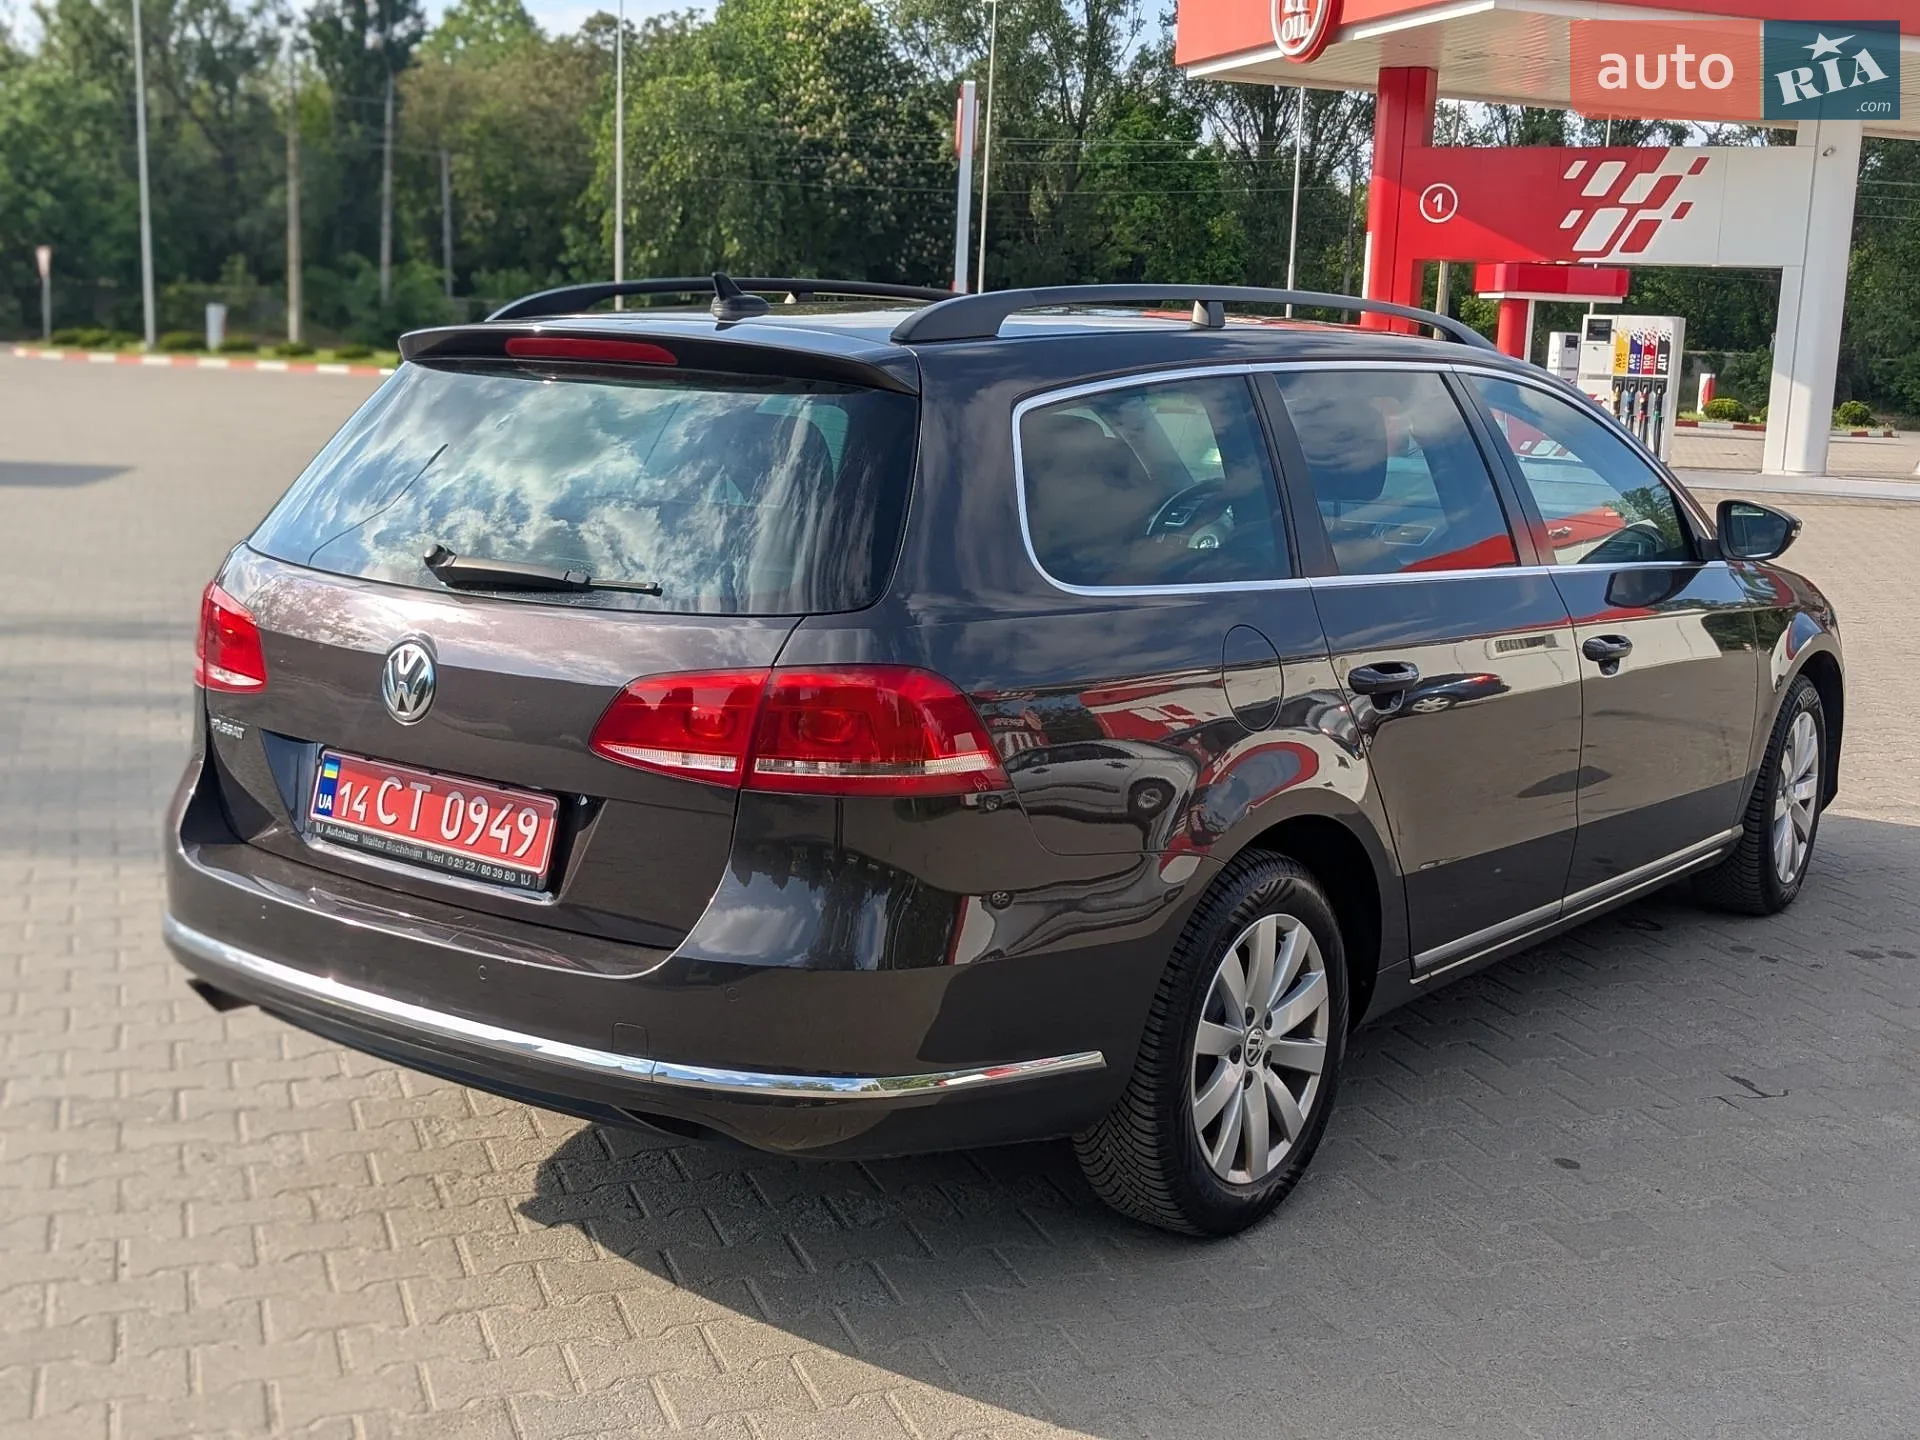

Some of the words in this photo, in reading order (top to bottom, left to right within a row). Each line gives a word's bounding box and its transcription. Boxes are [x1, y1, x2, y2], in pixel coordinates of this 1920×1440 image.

[1281, 13, 1310, 42] OIL
[1657, 353, 1668, 371] ДП
[318, 793, 333, 811] UA
[339, 781, 369, 822] 14
[377, 776, 431, 832] CT
[441, 788, 538, 858] 0949
[325, 825, 359, 843] Autohaus
[362, 833, 386, 850] Walter
